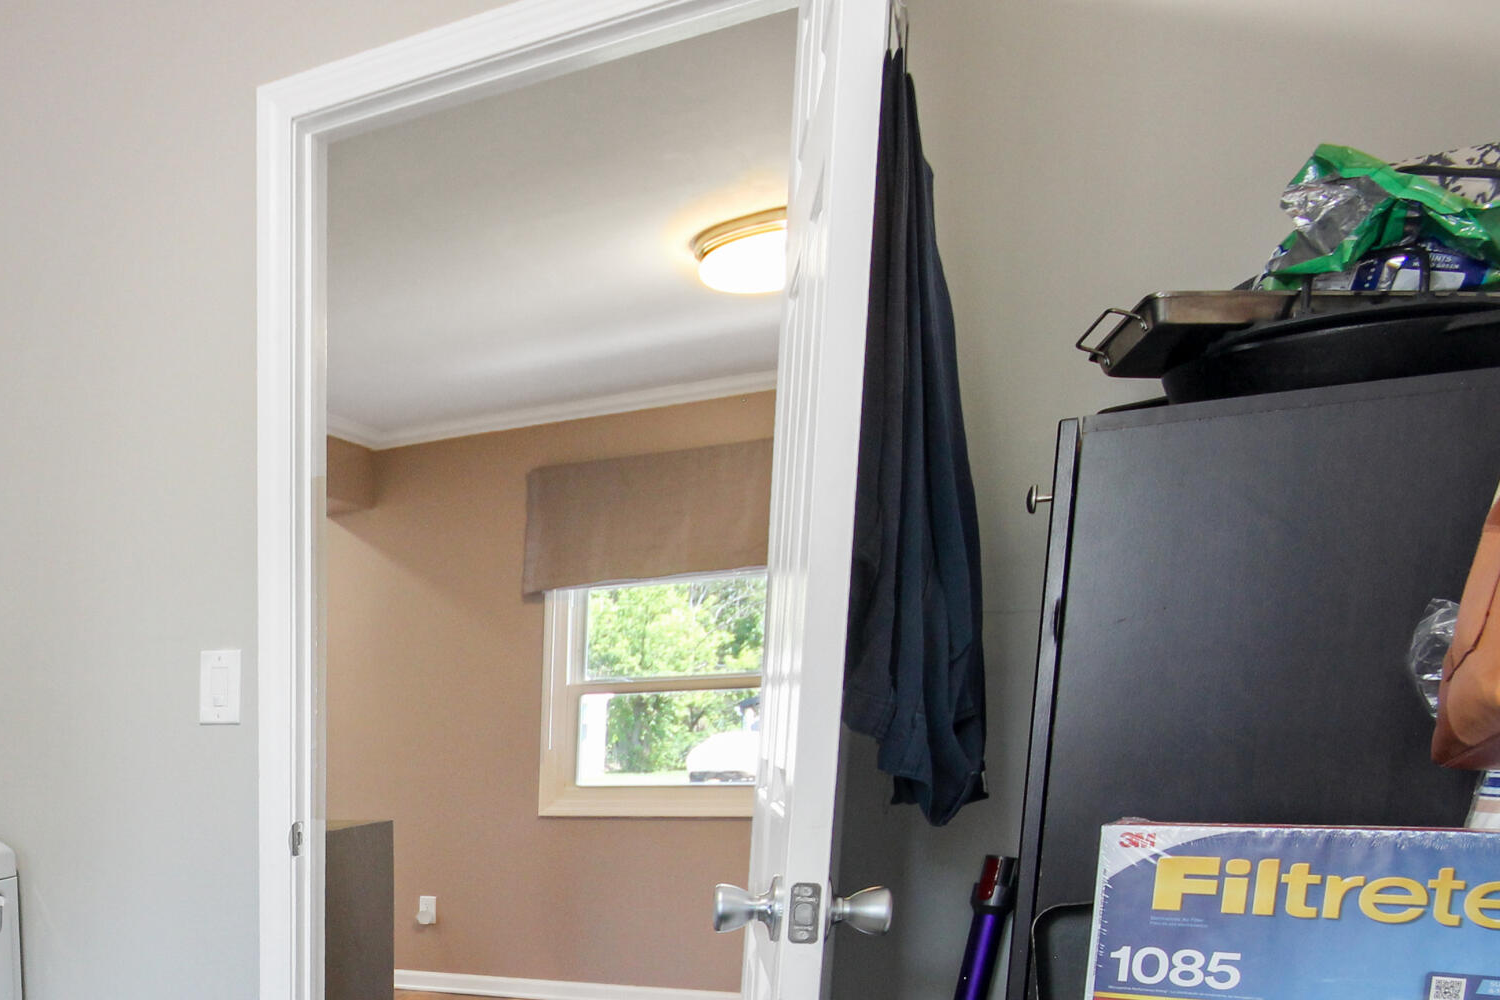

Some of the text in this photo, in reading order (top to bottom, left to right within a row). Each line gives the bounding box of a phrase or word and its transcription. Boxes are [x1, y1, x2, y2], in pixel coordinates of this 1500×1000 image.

[1119, 832, 1156, 848] 3M
[1151, 856, 1500, 930] Filtrete
[1110, 945, 1242, 990] 1085
